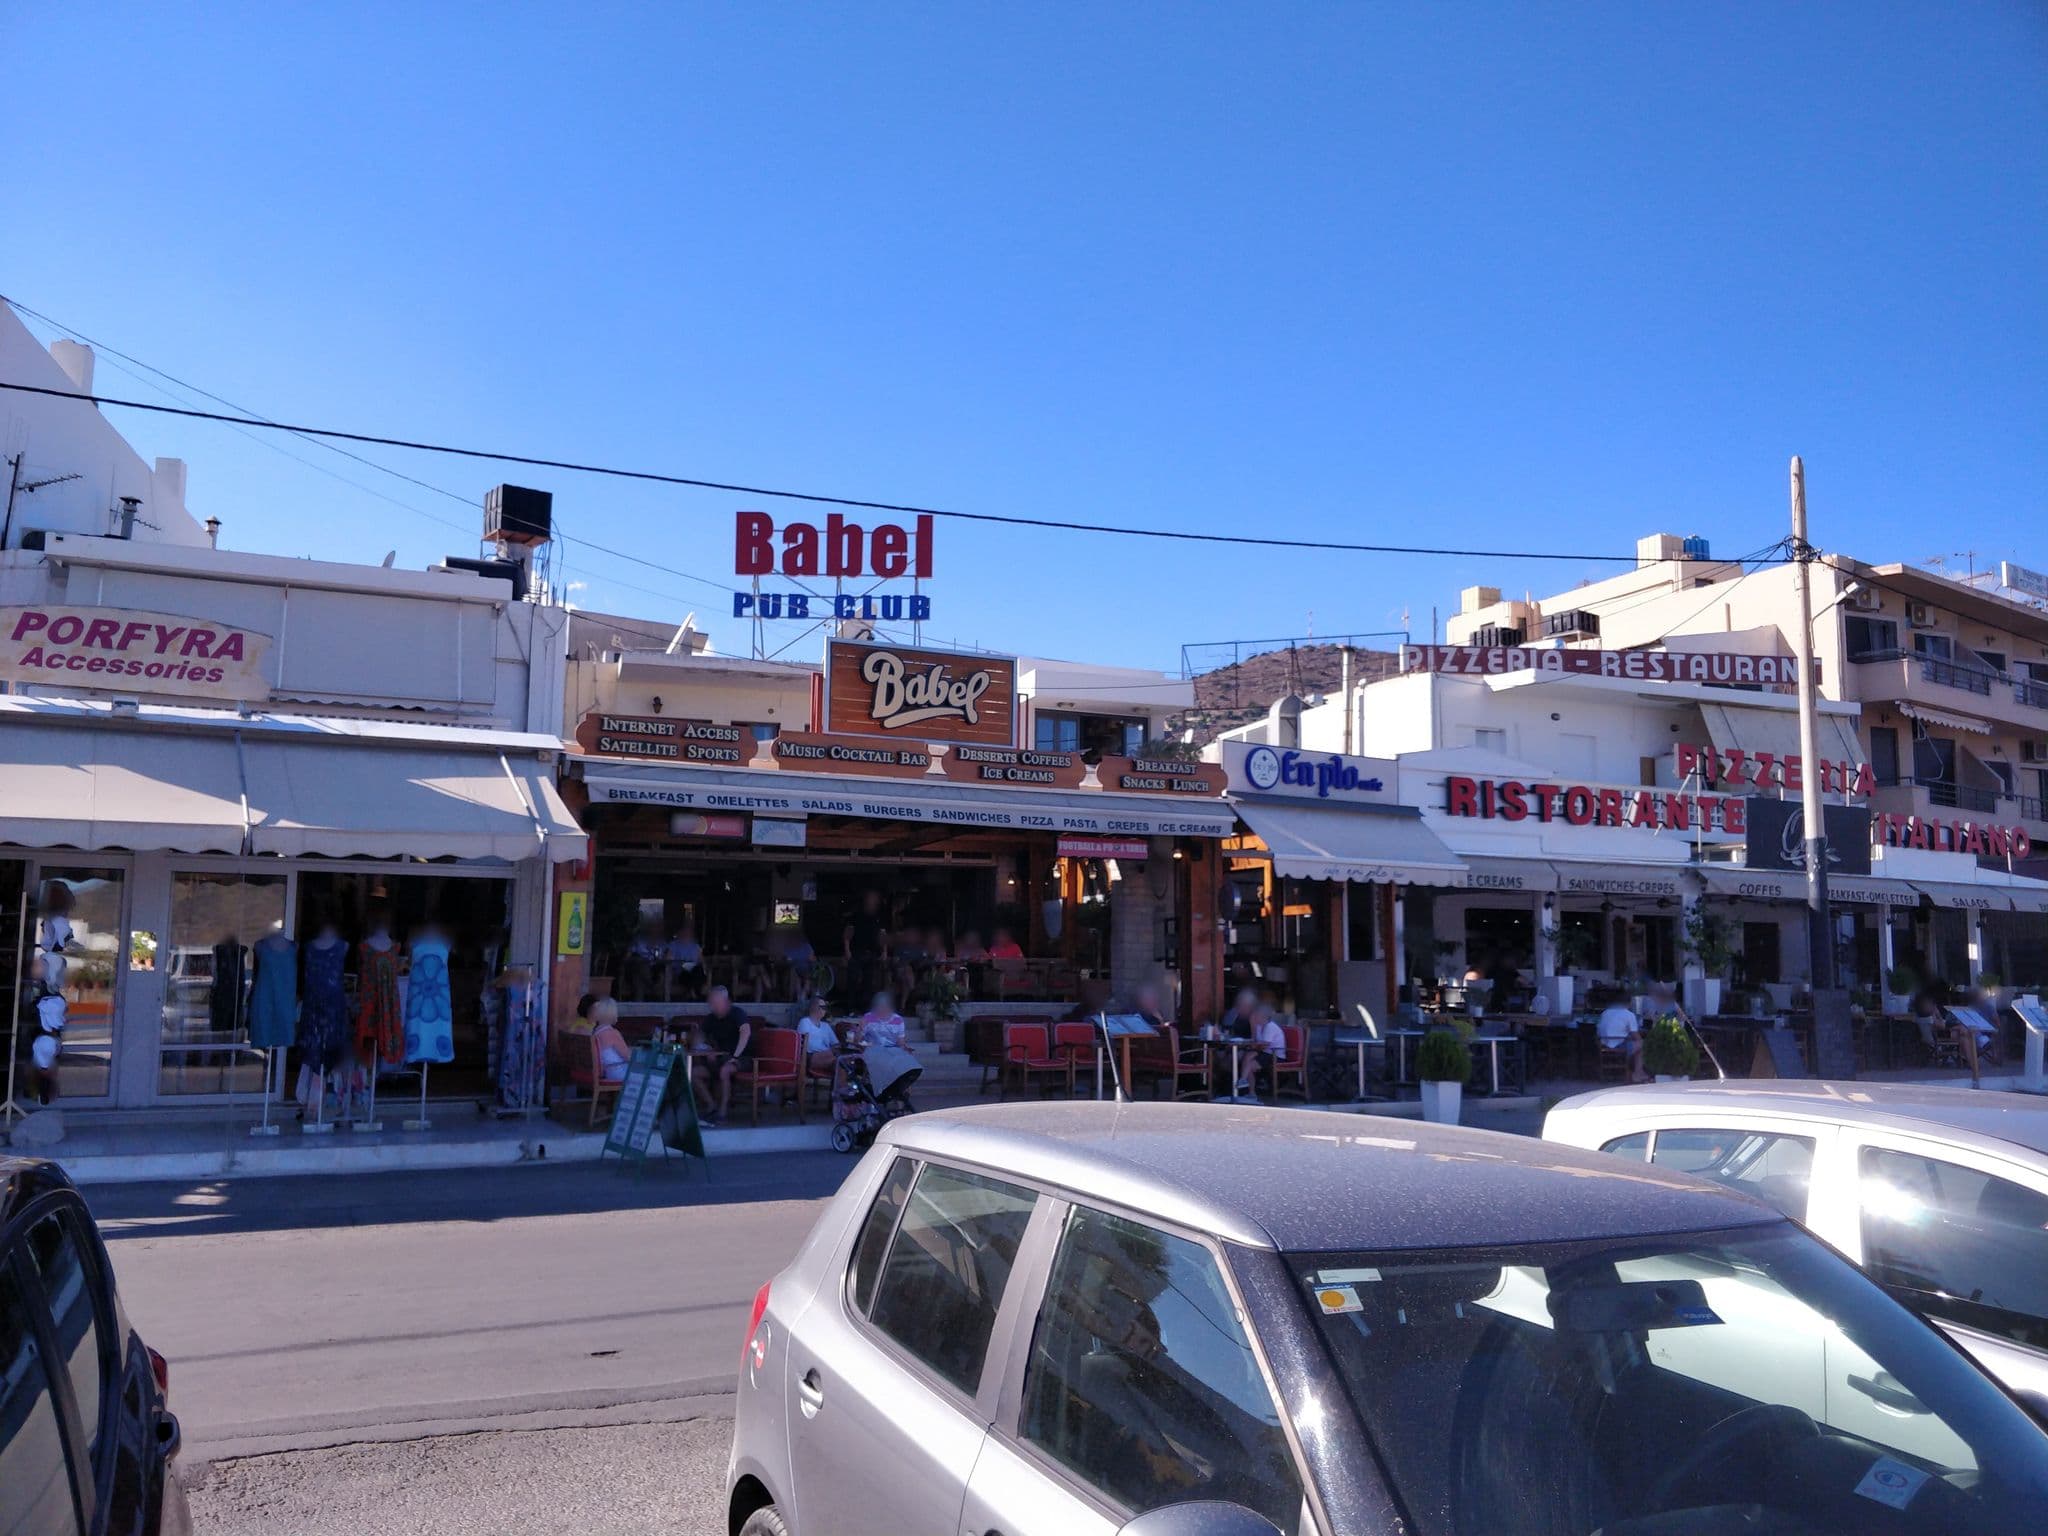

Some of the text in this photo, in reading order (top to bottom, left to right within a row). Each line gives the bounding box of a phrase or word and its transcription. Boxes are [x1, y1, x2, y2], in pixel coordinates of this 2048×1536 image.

[735, 511, 933, 579] Babel
[733, 592, 931, 620] PUB CLUB
[11, 611, 245, 662] PORFYRA
[19, 646, 224, 683] Accessories
[1403, 645, 1563, 672] PIZZERIA
[863, 651, 990, 729] Babel
[601, 717, 740, 742] INTERNET ACCESS
[600, 737, 740, 762] SATELLITE SPORTS
[1673, 742, 1877, 798] PIZZERIA
[608, 788, 1222, 835] BREAKFAST OMELETTES SALADS BURGERS SANDWICHES PIZZA PASTA CREPES ICE CREAMS
[1446, 776, 1745, 834] RISTORANTE
[1875, 812, 2031, 859] ITALIANO
[1476, 875, 1523, 890] CREAMS
[1738, 883, 1782, 898] COFFES
[1952, 897, 1990, 909] SALADS
